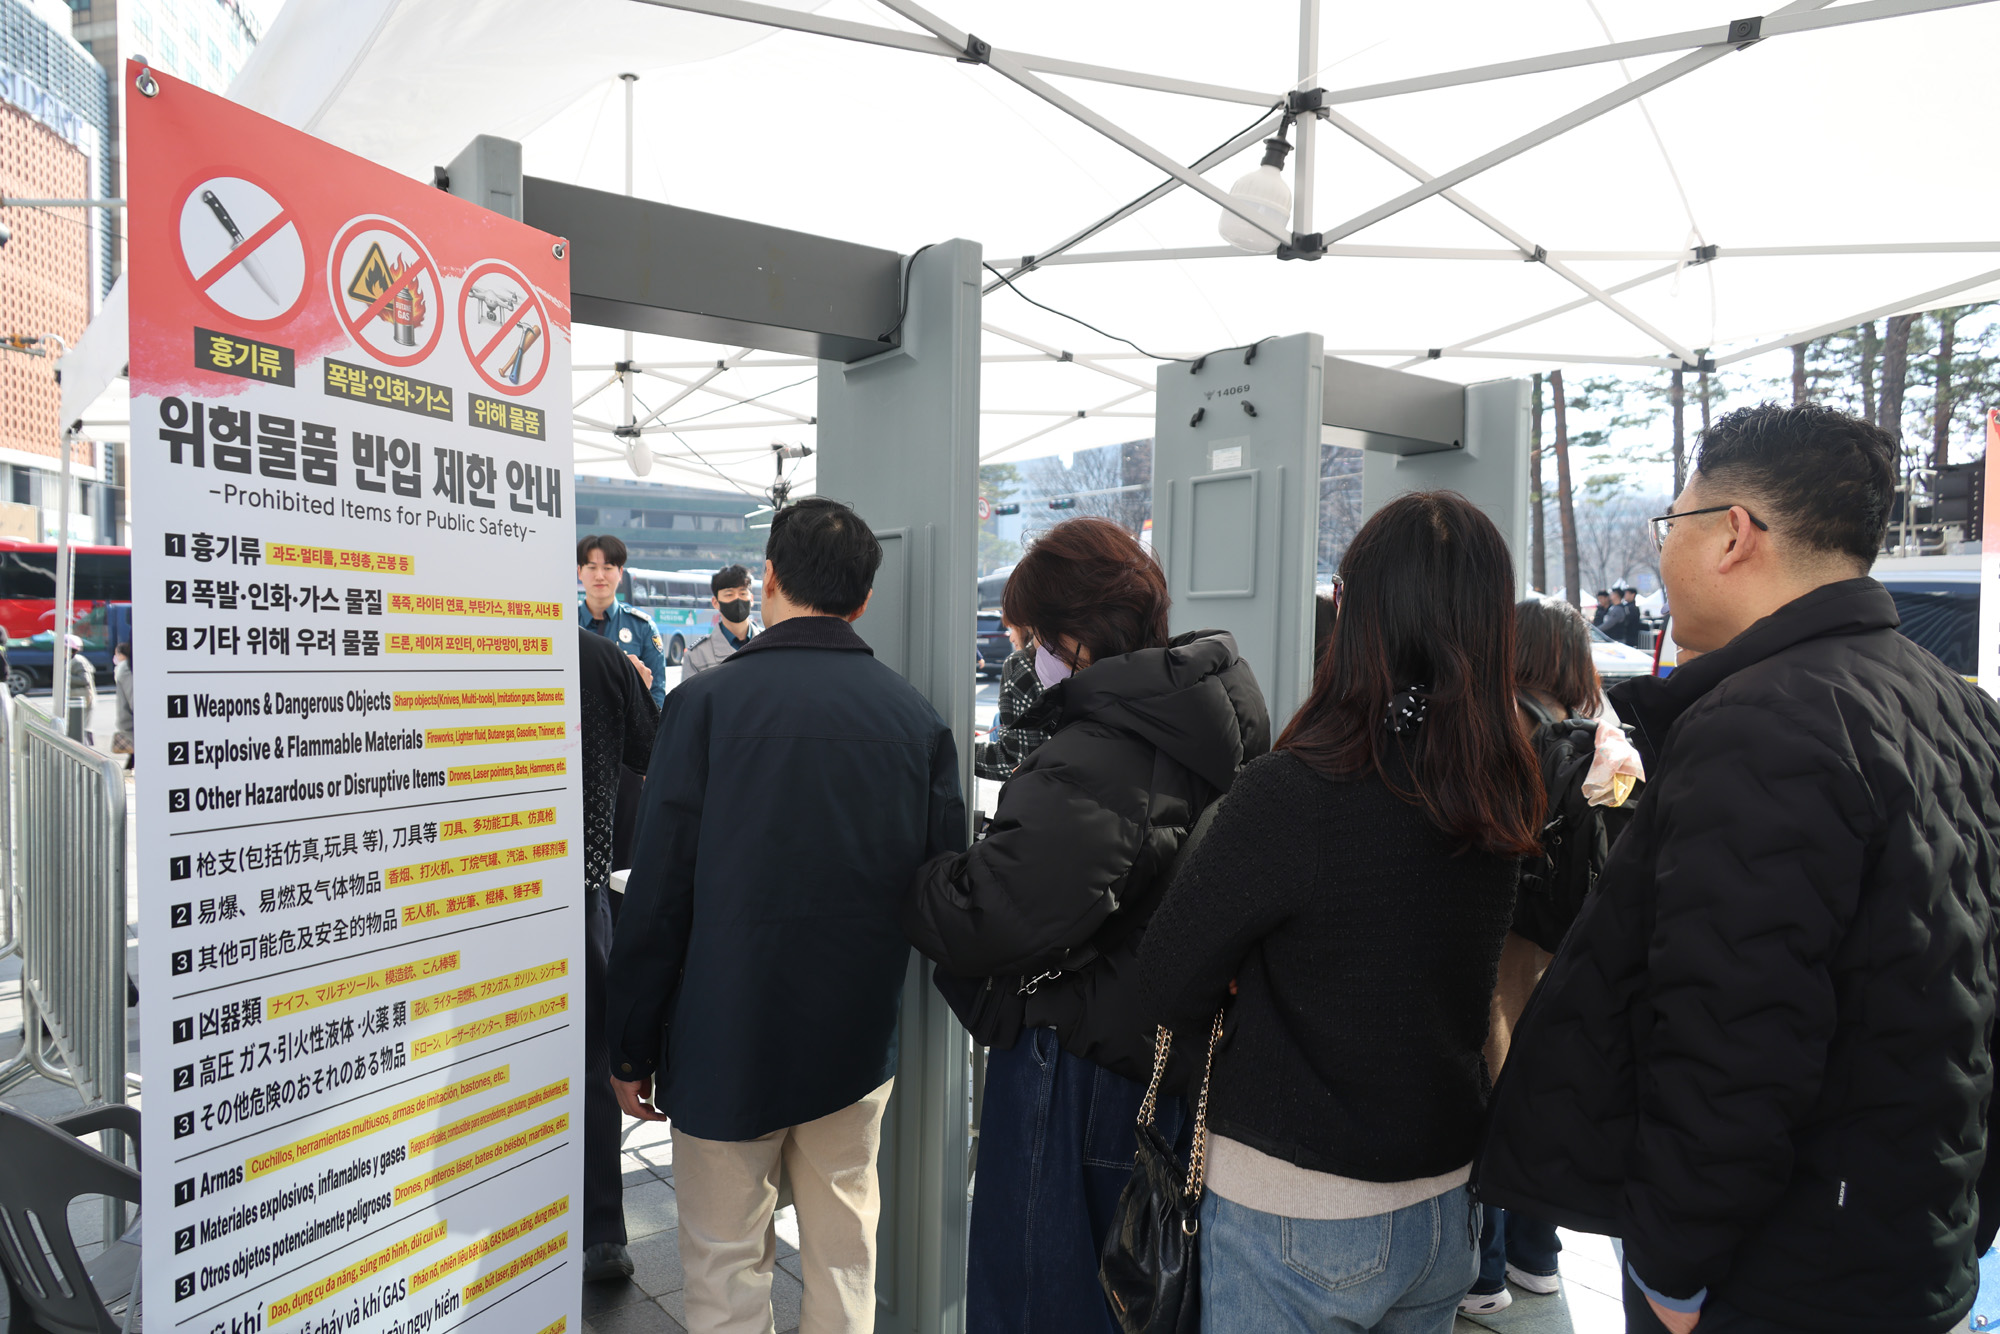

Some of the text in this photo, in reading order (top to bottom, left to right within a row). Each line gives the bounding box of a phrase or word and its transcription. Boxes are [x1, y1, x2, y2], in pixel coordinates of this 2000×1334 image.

[398, 310, 410, 321] GAS
[209, 336, 282, 378] 흉기류
[327, 363, 450, 413] 폭발·인화·가스
[1217, 384, 1251, 398] 14069
[474, 399, 540, 435] 위해 물품
[159, 396, 562, 518] 위험물품 반입 제한 안내
[341, 498, 392, 523] Items
[397, 506, 422, 526] for
[427, 510, 475, 532] Public
[171, 532, 408, 571] 1 흉기류 과도·멀티툴, 모형총, 곤봉 등
[171, 579, 559, 616] 2 폭발·인화·가스 물질 폭죽, 라이터 연료, 부탄가스, 휘발유, 시너 등
[171, 626, 548, 656] 3 기타 위해 우려 물품 드론, 레이저 포인터, 야구방망이, 망치 등
[174, 698, 181, 715] 1
[194, 694, 260, 722] Weapons
[264, 692, 272, 715] &
[276, 692, 343, 719] Dangerous
[347, 689, 391, 717] Objects
[395, 695, 413, 708] Sharp
[498, 692, 521, 702] Imitation
[522, 694, 536, 704] guns,
[537, 692, 554, 701] Batons
[555, 692, 564, 701] etc.
[174, 745, 184, 761] 2
[195, 737, 270, 769] Explosive
[274, 736, 284, 759] &
[288, 732, 362, 757] Flammable
[365, 729, 422, 752] Materials
[428, 732, 455, 743] Fireworks,
[456, 731, 473, 744] Lighter
[475, 730, 487, 741] fluid,
[488, 729, 505, 739] Butane
[506, 730, 514, 741] gas,
[517, 727, 536, 737] Gasoline,
[538, 726, 556, 736] Thinner,
[174, 762, 565, 811] 3 Other Hazardous or Disruptive Items Drones, Laser pointers, Bats, Hammers, etc.
[176, 860, 184, 876] 1
[176, 907, 187, 924] 2
[198, 871, 381, 924] 易爆、易燃及气体物品
[177, 954, 188, 971] 3
[198, 909, 397, 972] 其他可能危及安全的物品
[179, 1022, 187, 1039] 1
[200, 997, 261, 1040] 凶器類
[179, 1069, 189, 1086] 2
[179, 1116, 190, 1134] 3
[201, 1042, 405, 1131] その他危険のおそれのある物品
[180, 1072, 505, 1200] 1 Armas Cuchillos, herramientas multiusos, armas de imitación, bastones, etc.
[180, 1146, 405, 1250] 2 Materiales explosivos, inflamables y gases
[180, 1119, 566, 1296] 3 Otros objetos potencialmente peligrosos Drones, punteros láser, bates de béisbol, martillos, etc.
[231, 1301, 263, 1334] khí
[272, 1303, 290, 1319] Dao,
[292, 1291, 313, 1309] dụng
[315, 1286, 323, 1299] cụ
[326, 1278, 335, 1292] đa
[337, 1269, 358, 1286] năng,
[360, 1259, 377, 1275] súng
[379, 1249, 390, 1266] mô
[392, 1242, 409, 1259] hình,
[411, 1234, 421, 1250] dùi
[423, 1228, 433, 1243] cui
[434, 1226, 445, 1238] v.v.
[346, 1298, 360, 1328] và
[362, 1285, 382, 1320] khí
[383, 1278, 406, 1309] GAS
[407, 1306, 433, 1334] nguy
[434, 1288, 460, 1321] hiểm
